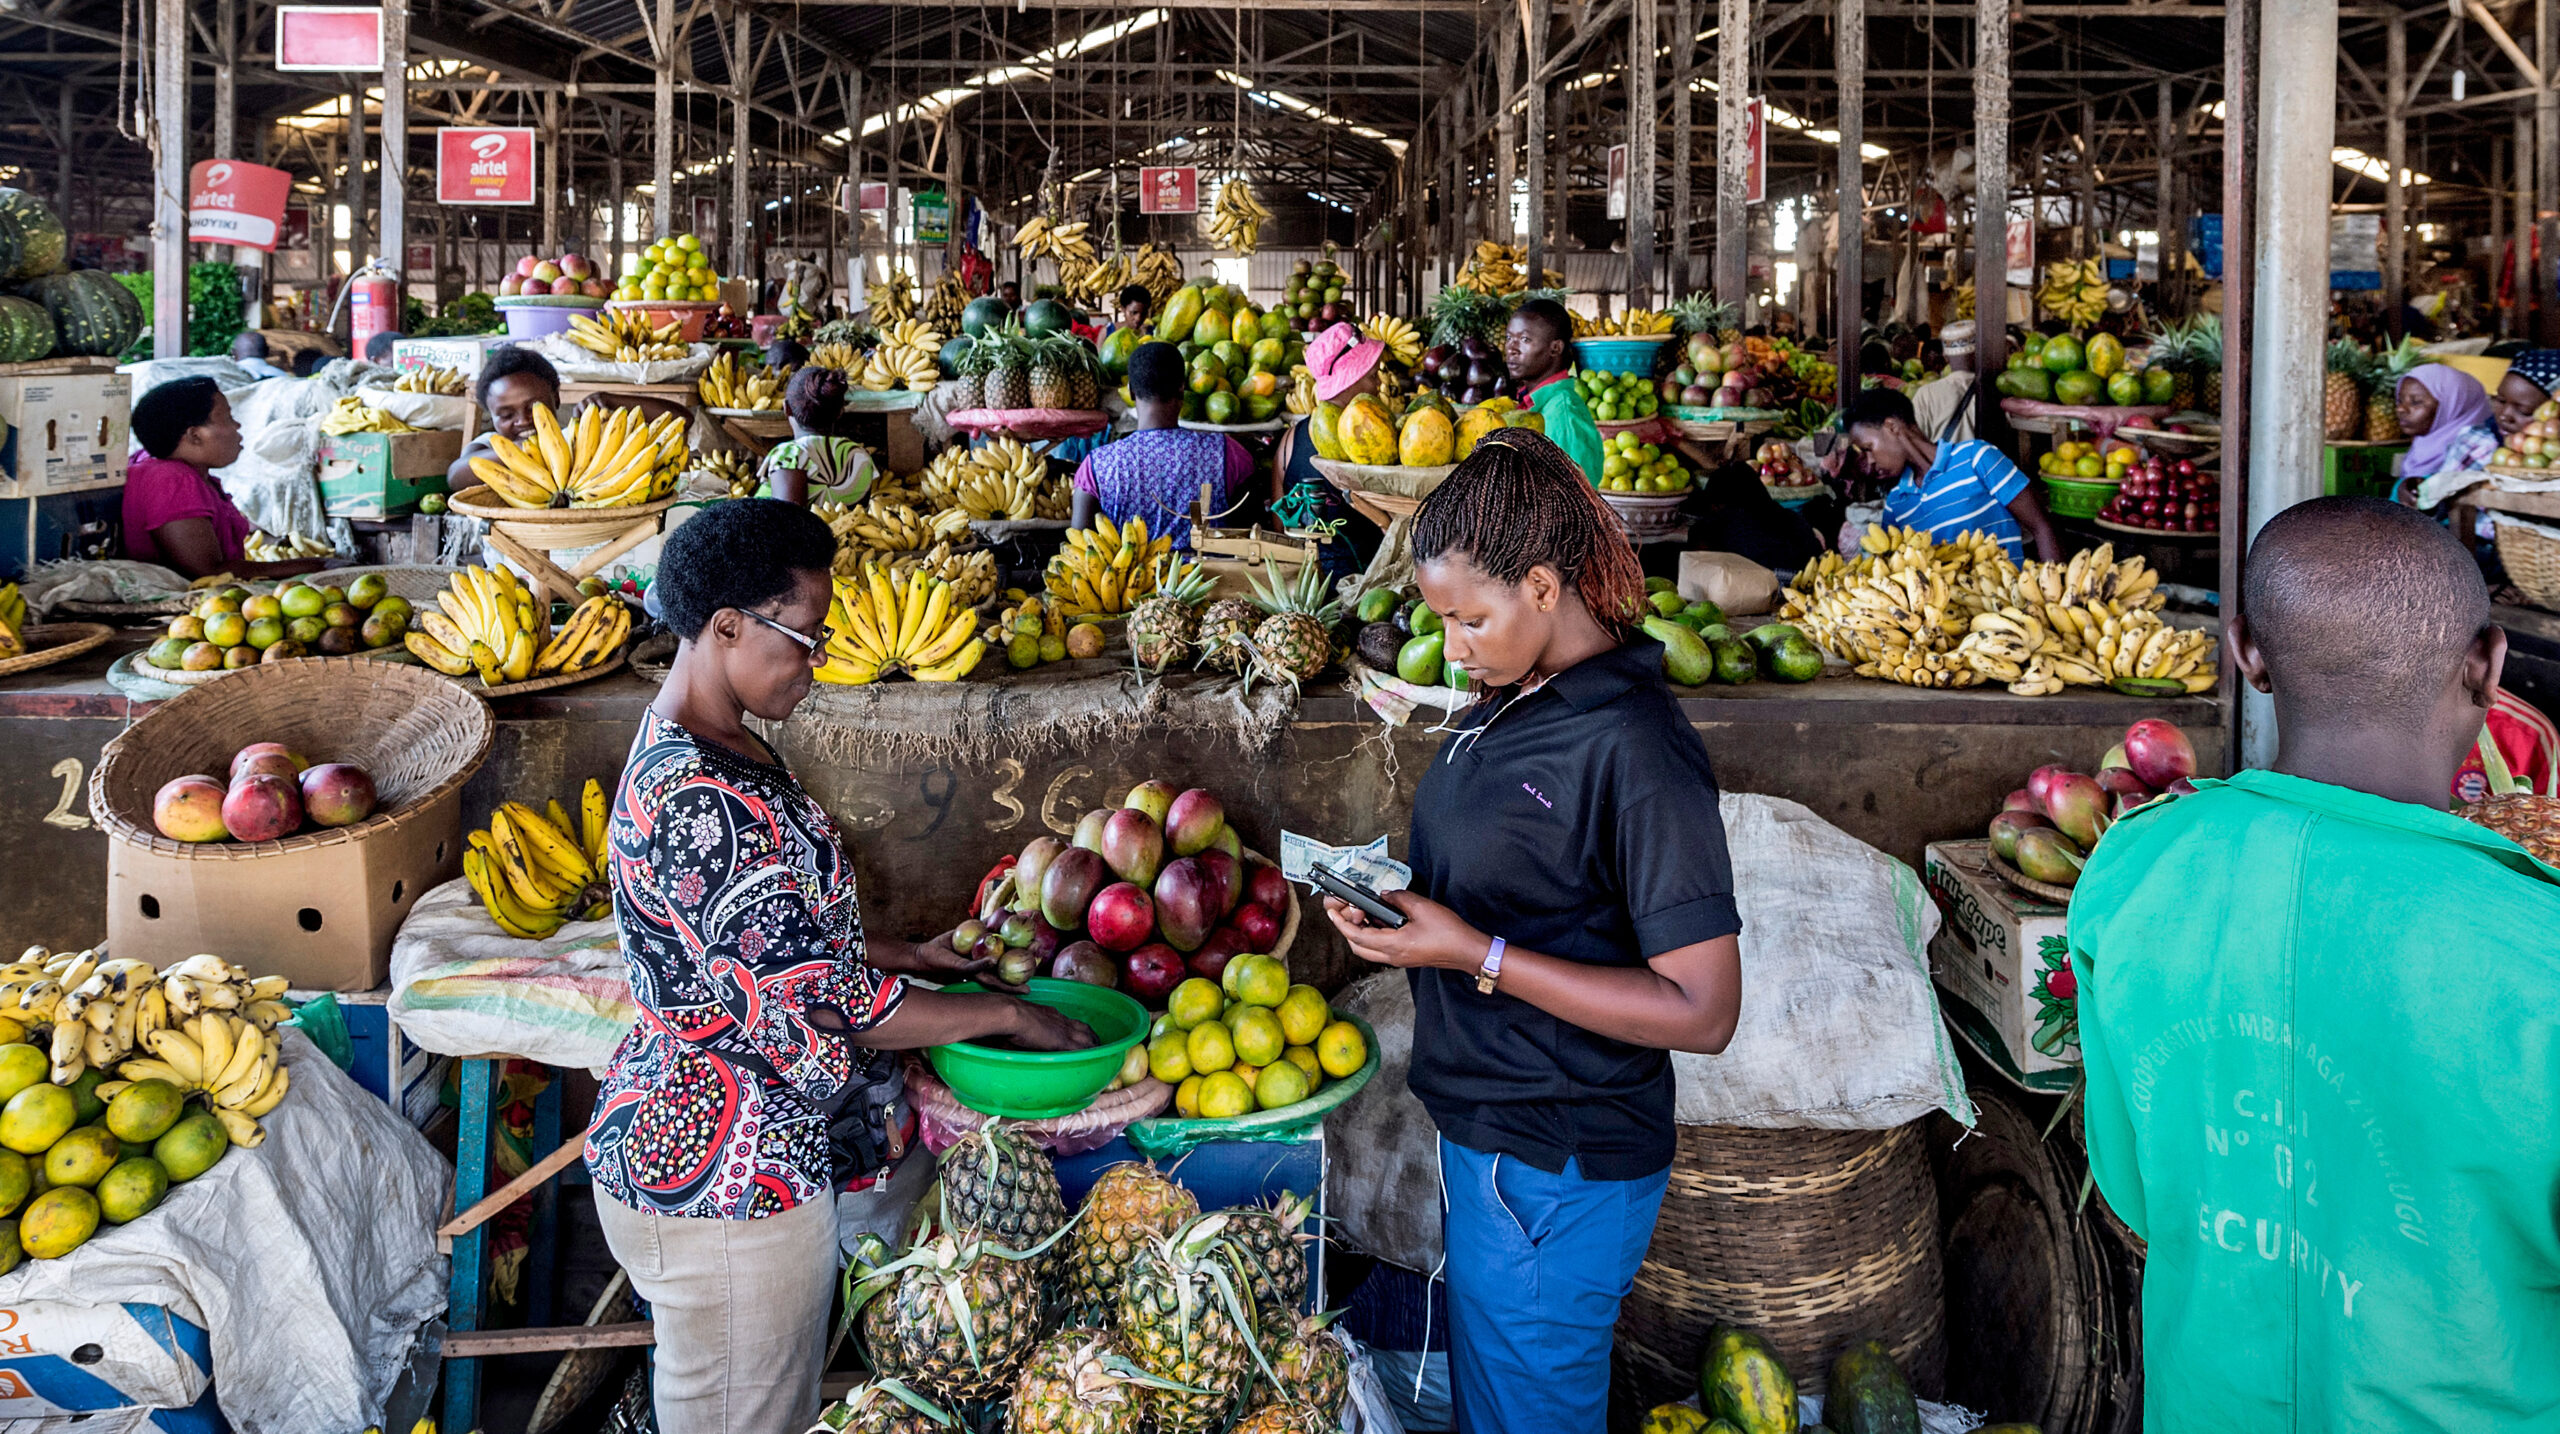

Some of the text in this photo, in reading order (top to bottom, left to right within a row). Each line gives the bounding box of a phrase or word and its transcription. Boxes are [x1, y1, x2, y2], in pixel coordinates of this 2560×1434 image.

[193, 190, 235, 208] airtel
[470, 160, 508, 176] airtel
[405, 344, 470, 363] Tru-Cape
[43, 757, 91, 831] 2
[1934, 859, 2007, 949] Tru-Cape
[2132, 1016, 2223, 1113] COOPERATIVE
[2274, 1143, 2319, 1207] 02
[2198, 1200, 2364, 1319] ECURITY
